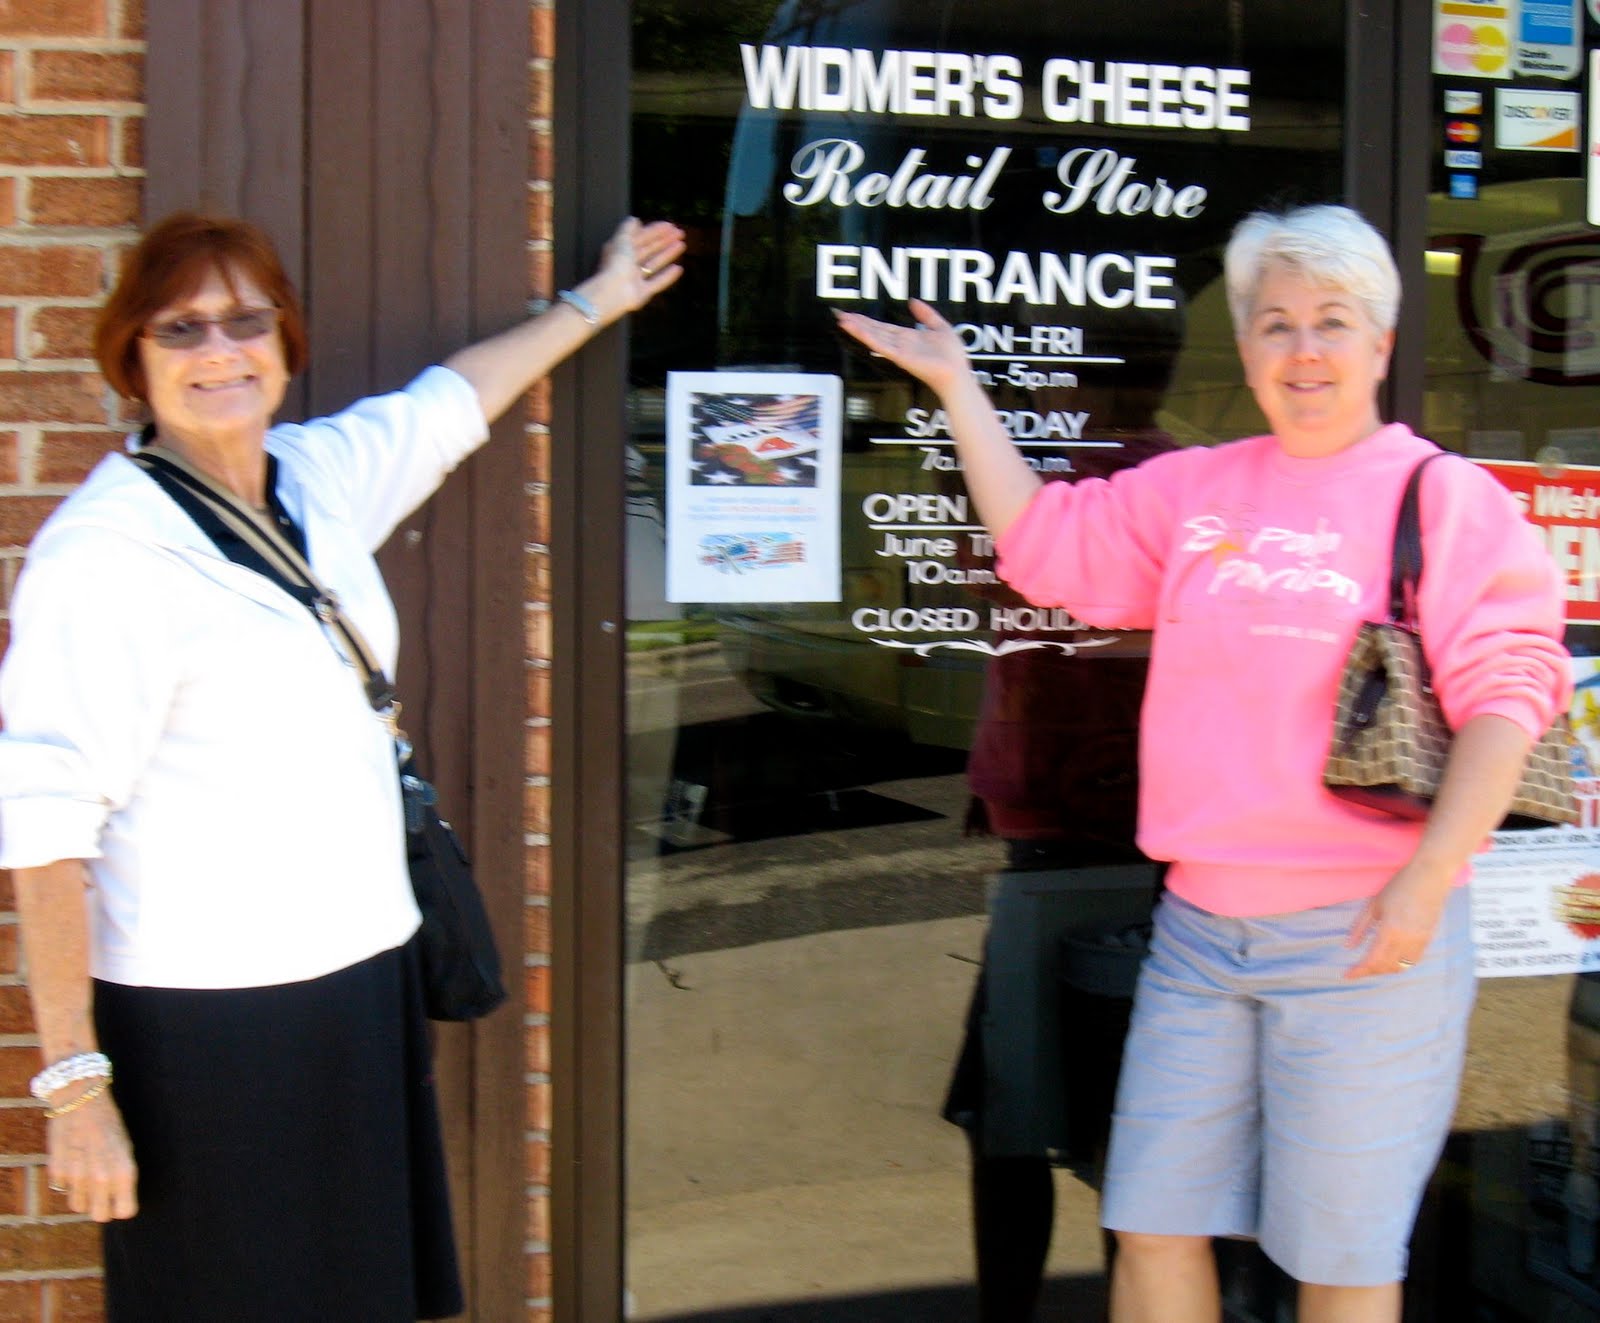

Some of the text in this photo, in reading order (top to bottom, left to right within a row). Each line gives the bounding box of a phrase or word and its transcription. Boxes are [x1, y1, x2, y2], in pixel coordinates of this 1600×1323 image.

[740, 43, 1251, 131] WIDMER'S CHEESE
[783, 138, 1207, 218] Retail Store
[816, 243, 1177, 309] ENTRANCE
[915, 323, 1083, 355] ON-FRI
[904, 408, 1090, 439] SARDAY
[862, 493, 968, 522] OPEN
[875, 533, 958, 557] June
[851, 607, 1130, 632] CLOSED HOLID
